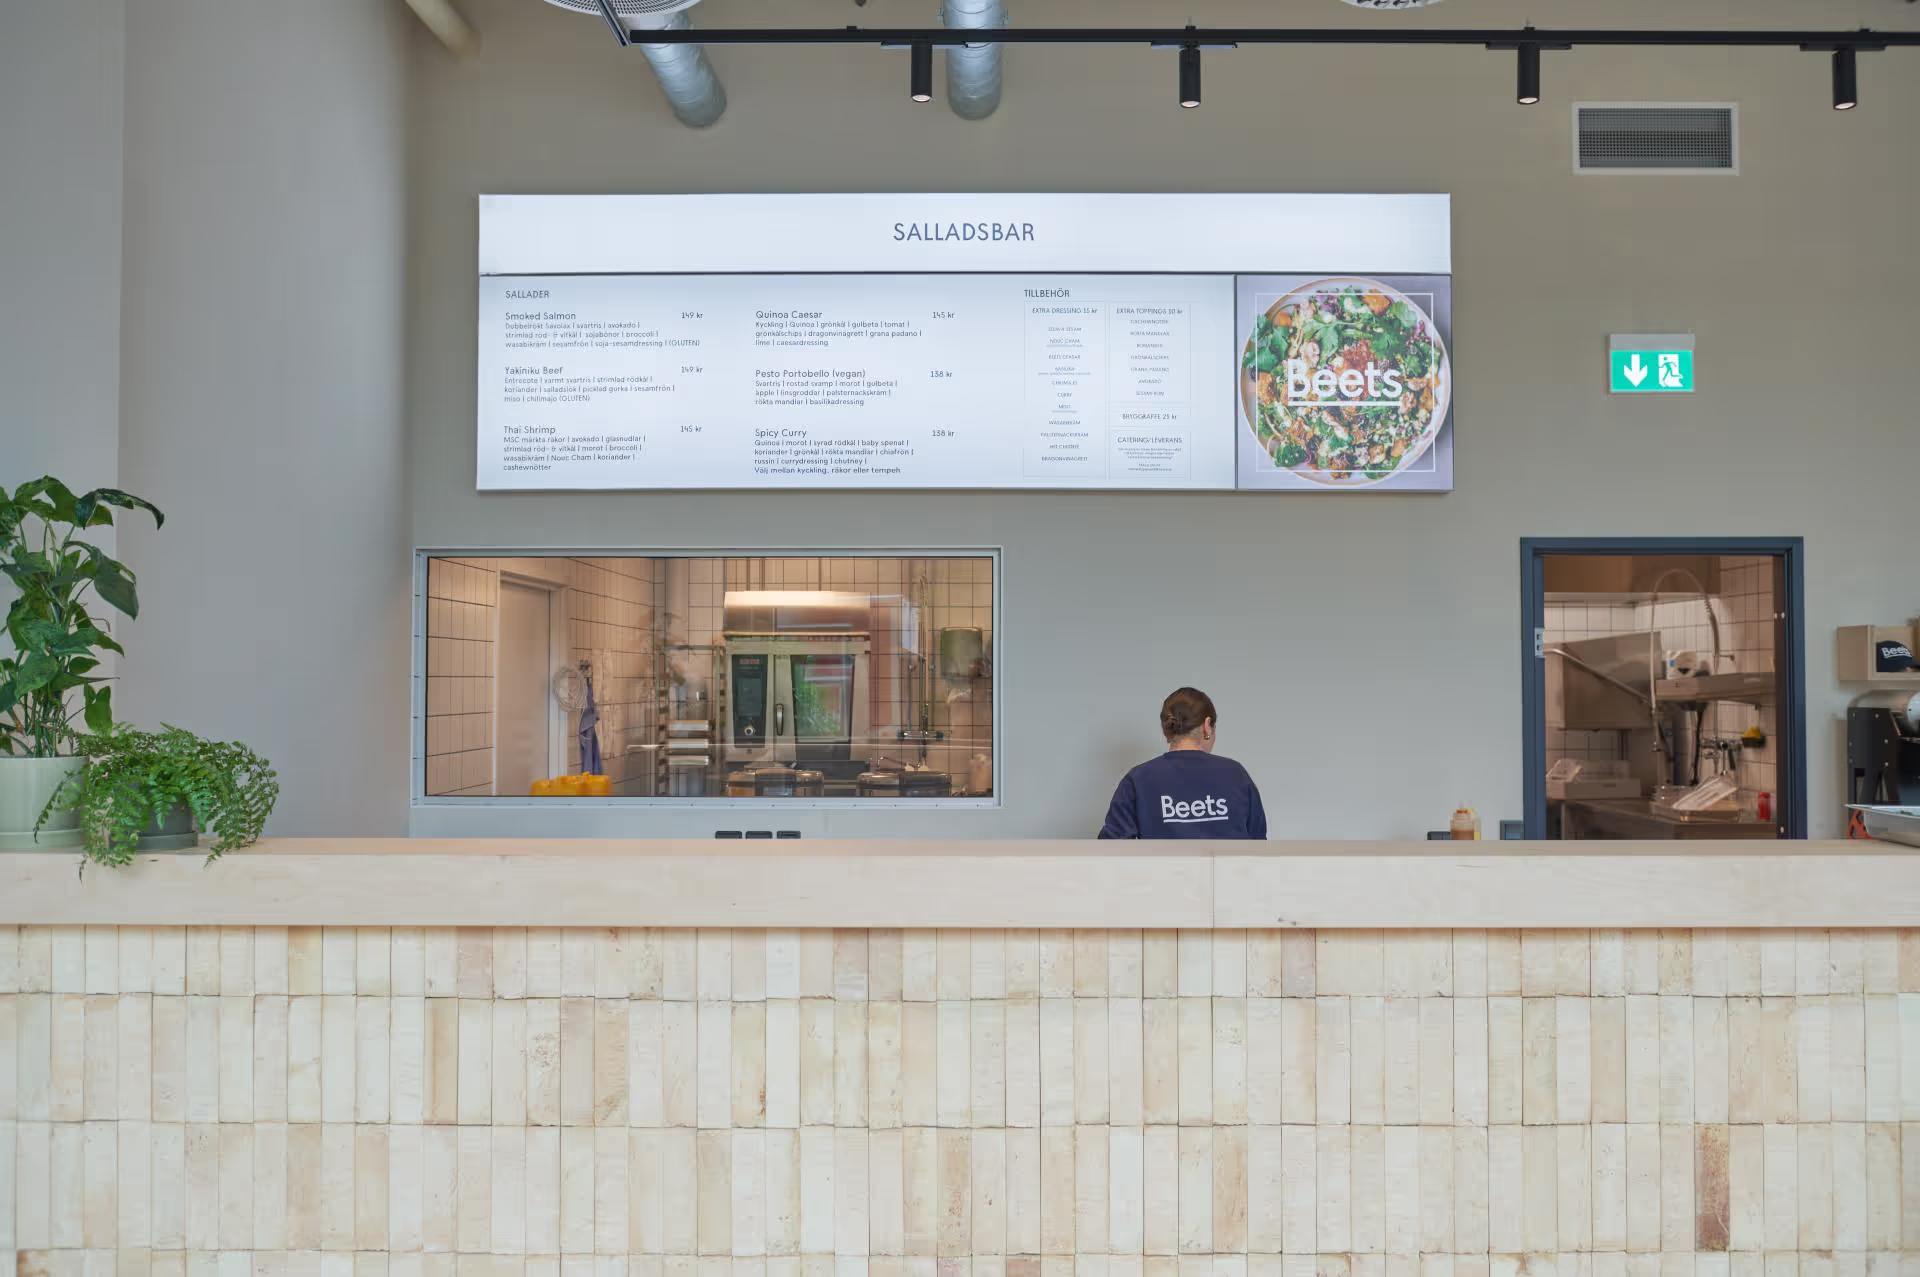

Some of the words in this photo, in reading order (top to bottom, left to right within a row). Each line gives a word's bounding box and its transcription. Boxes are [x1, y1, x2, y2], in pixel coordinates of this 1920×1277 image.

[893, 222, 1035, 241] SALLADSBAR
[505, 290, 551, 299] SALLADER
[1024, 288, 1070, 298] TILLBEHÖR
[505, 312, 541, 320] Smoked
[543, 312, 576, 320] Salmon
[756, 310, 789, 319] Quinoa
[791, 310, 823, 319] Caesar
[933, 311, 945, 319] 145
[505, 366, 540, 375] Yakiniku
[543, 366, 563, 375] Beef
[756, 369, 780, 378] Pesto
[783, 369, 830, 378] Portobello
[832, 370, 865, 379] (vegan)
[930, 370, 944, 378] 138
[1288, 358, 1403, 398] Beets
[504, 426, 522, 434] Thai
[523, 425, 556, 435] Shrimp
[680, 425, 693, 433] 145
[755, 429, 779, 438] Spicy
[781, 428, 807, 438] Curry
[1160, 794, 1228, 818] Beets
